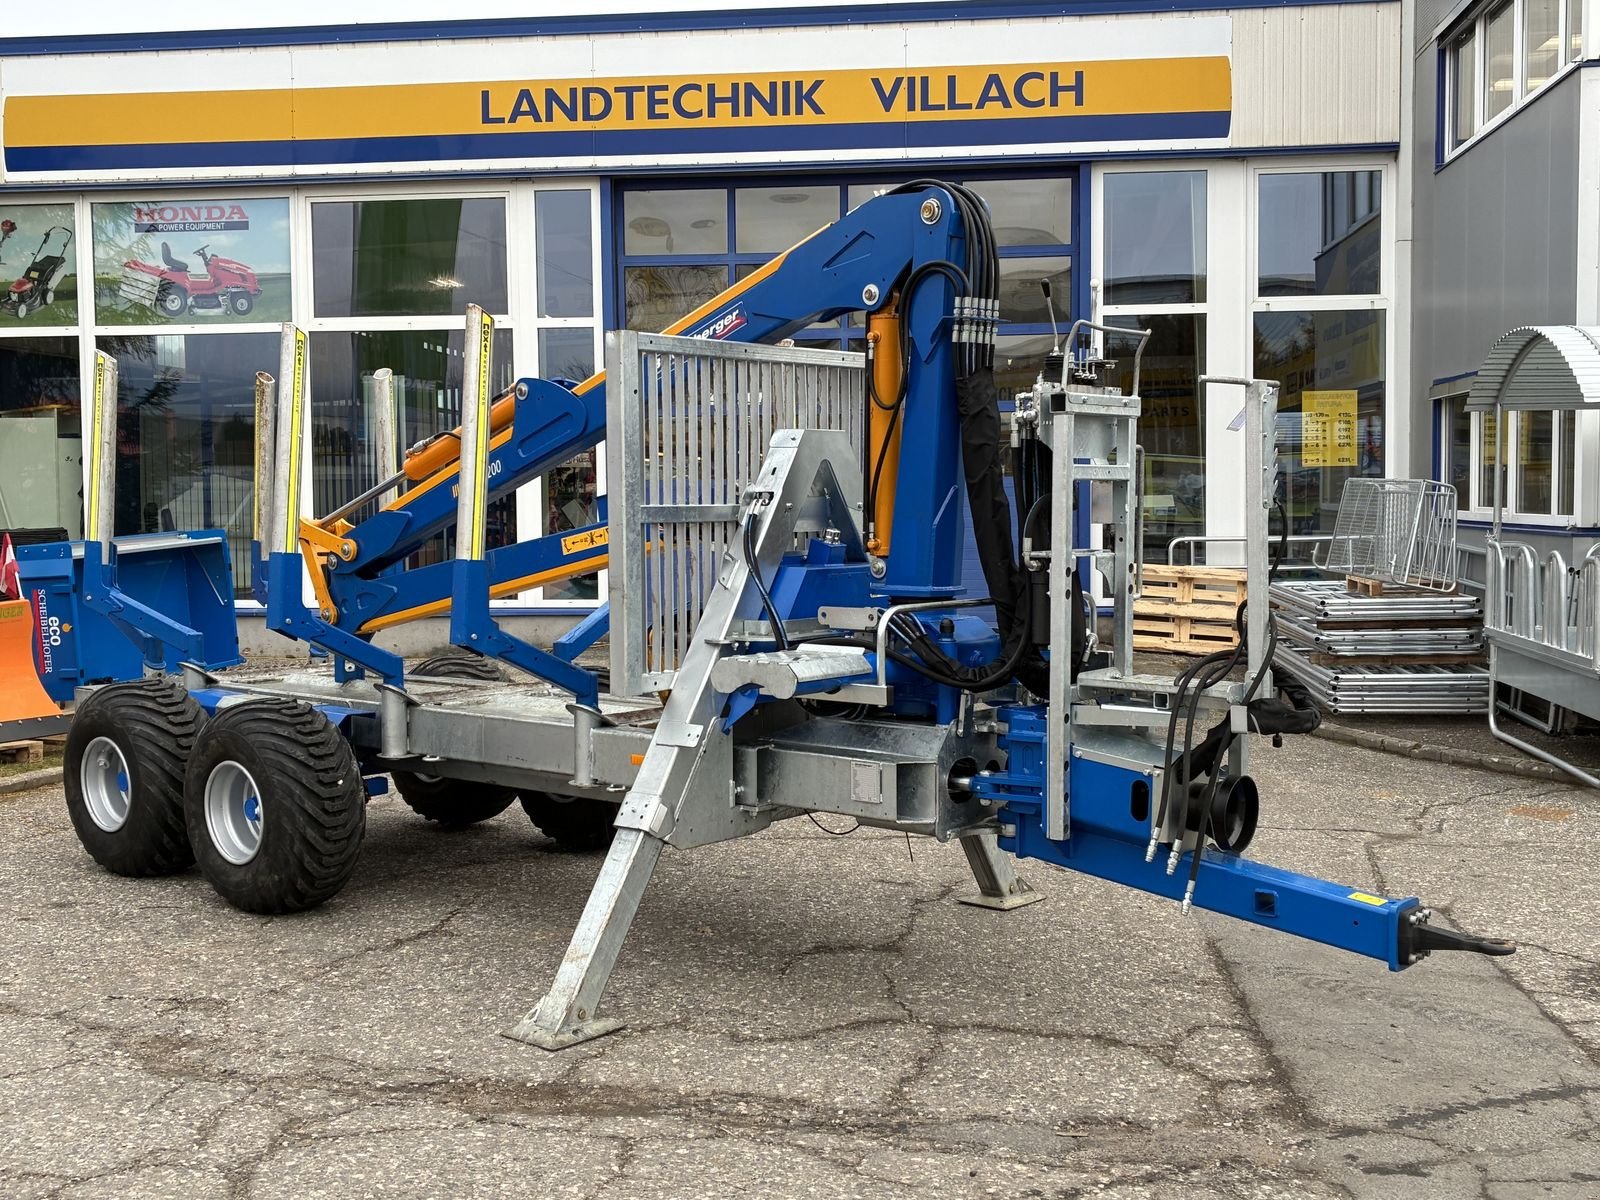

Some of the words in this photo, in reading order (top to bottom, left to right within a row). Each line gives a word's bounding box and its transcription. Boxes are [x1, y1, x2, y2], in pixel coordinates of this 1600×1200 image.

[481, 79, 826, 124] LANDTECHNIK
[870, 70, 1085, 113] VILLACH
[134, 204, 248, 224] HONDA
[158, 221, 184, 232] POWER
[185, 221, 226, 232] EQUIPMENT
[38, 589, 53, 674] SCHEIBELHOFER
[48, 616, 61, 646] eco
